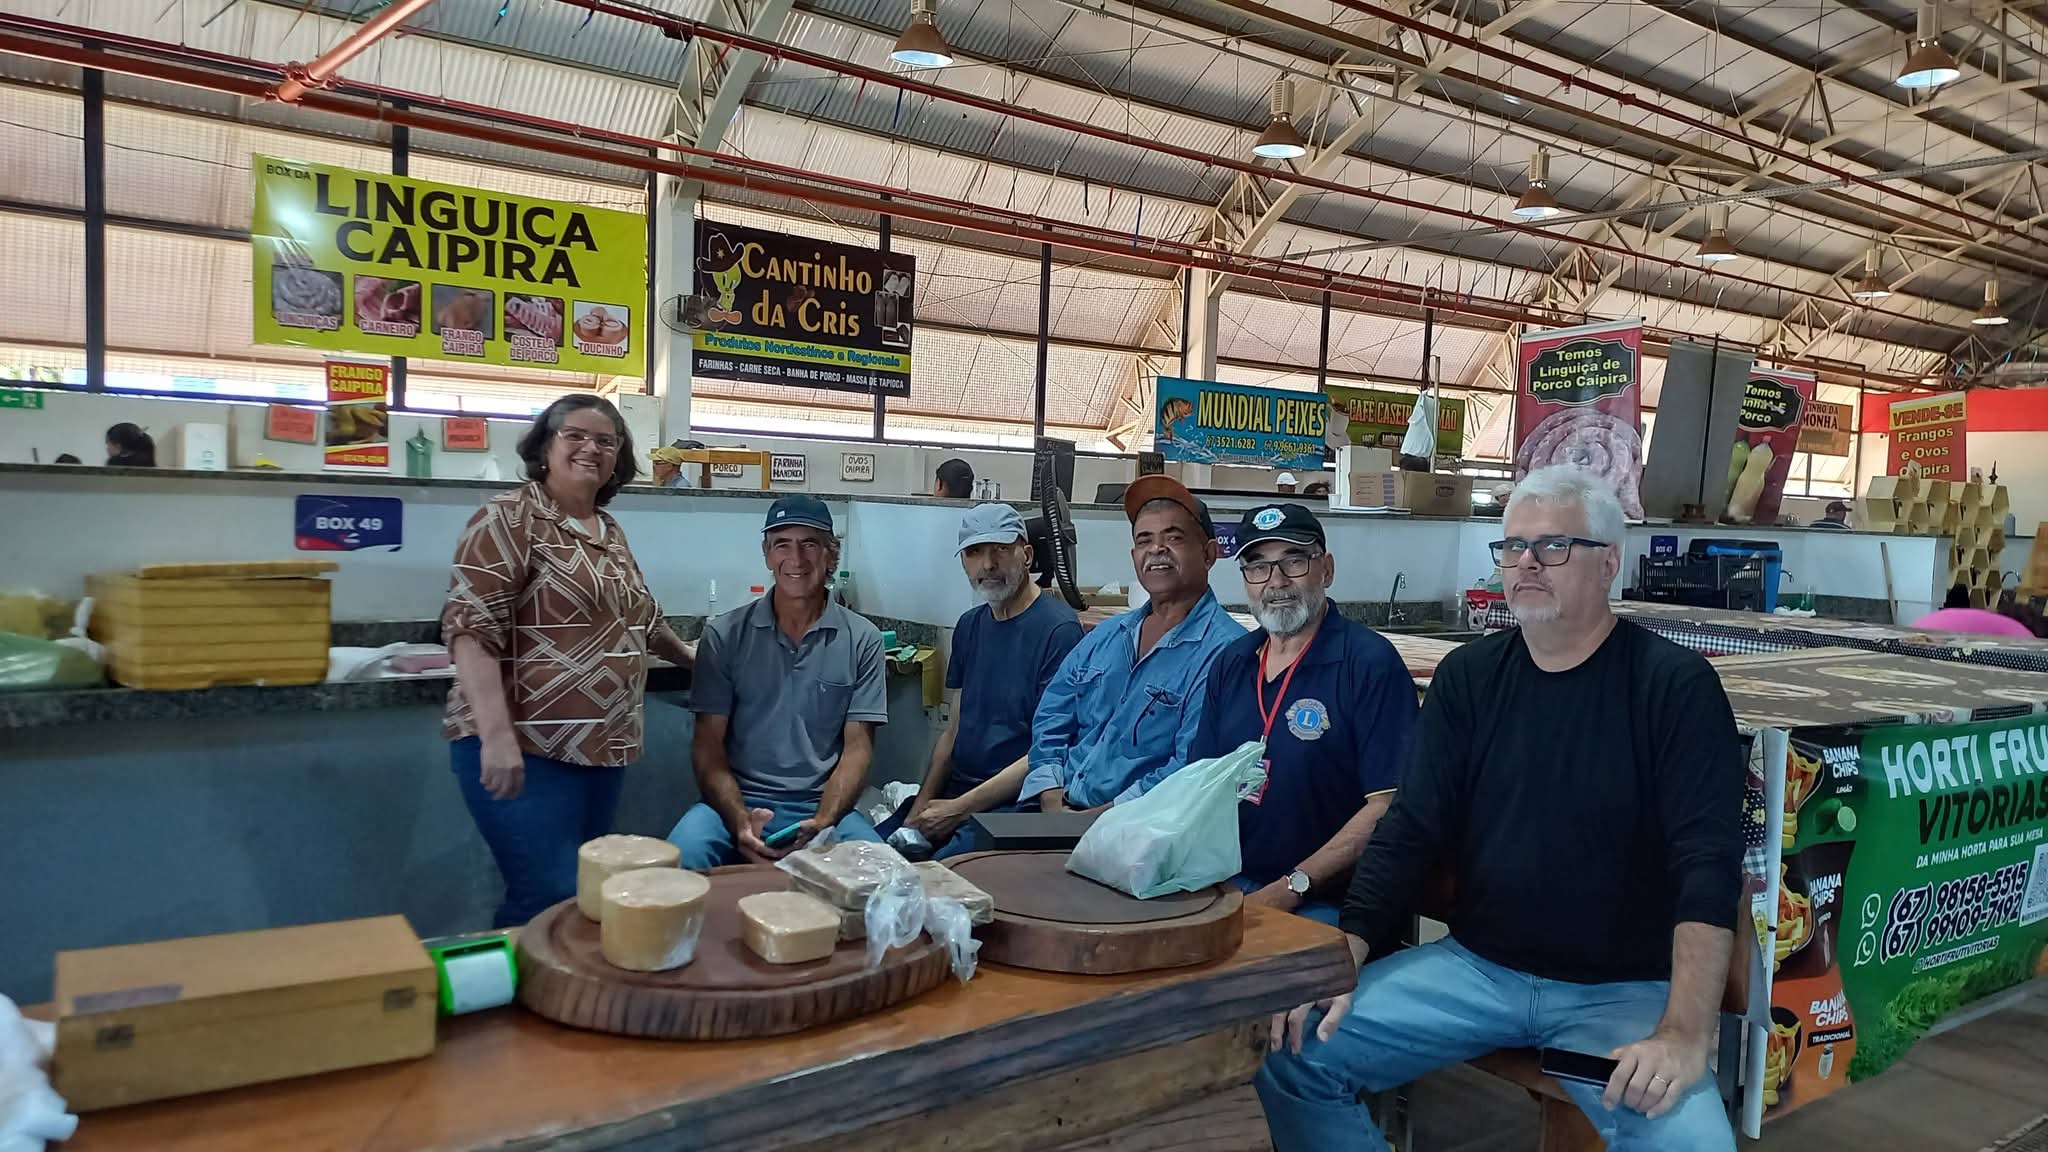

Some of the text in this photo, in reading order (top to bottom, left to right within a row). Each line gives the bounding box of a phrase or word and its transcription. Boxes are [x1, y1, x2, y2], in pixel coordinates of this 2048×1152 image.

[266, 164, 291, 177] BOX
[315, 171, 599, 252] LINGUIÇA
[336, 220, 581, 288] CAIPIRA
[360, 320, 416, 337] CARNEIRO
[442, 329, 482, 343] FRANGO
[442, 341, 483, 355] CAIPIRA
[512, 336, 555, 350] COSTELA
[579, 343, 623, 356] TOUCINHO
[704, 333, 762, 351] Produtos
[764, 340, 834, 360] Nordestinos
[847, 350, 901, 367] Regionais
[510, 348, 557, 362] DE PORCO
[1556, 348, 1603, 361] Temos
[329, 364, 384, 381] FRANGO
[698, 358, 904, 390] FARINHAS CARNE SECA BANHA DE PORCO MASSA DE TAPIOCA
[1539, 359, 1621, 378] Linguiça de
[329, 378, 385, 395] CAIPIRA
[1532, 373, 1628, 392] Porco Caipira
[1745, 384, 1782, 400] Temos
[1197, 390, 1327, 438] MUNDIAL PEIXES
[1349, 397, 1375, 423] CAFÉ
[1376, 401, 1413, 427] CASEIR
[1892, 402, 1964, 426] VENDE-SE
[1898, 427, 1954, 443] Frangos
[848, 456, 869, 465] OVOS
[1901, 446, 1949, 460] e Ovos
[712, 463, 739, 474] PORCO
[773, 457, 803, 468] FARINHA
[845, 464, 870, 475] CAIPIRA
[1899, 463, 1951, 479] Cipira
[316, 516, 384, 530] BOX 49
[1823, 745, 1860, 765] BANANA
[1832, 760, 1859, 779] CHIPS
[1881, 734, 1983, 799] HORTI
[1916, 855, 1929, 869] DA
[1931, 849, 1960, 866] MINHA
[1961, 842, 1987, 860] HORTA
[1988, 836, 2008, 853] PARA
[2010, 831, 2025, 847] SUA
[1813, 888, 1835, 910] CHIPS
[1887, 860, 2030, 924] (67) 98158-5515
[1880, 917, 1924, 965] (67)
[1815, 1005, 1849, 1027] CHIPS
[1812, 1030, 1851, 1044] TRADICIONAL
